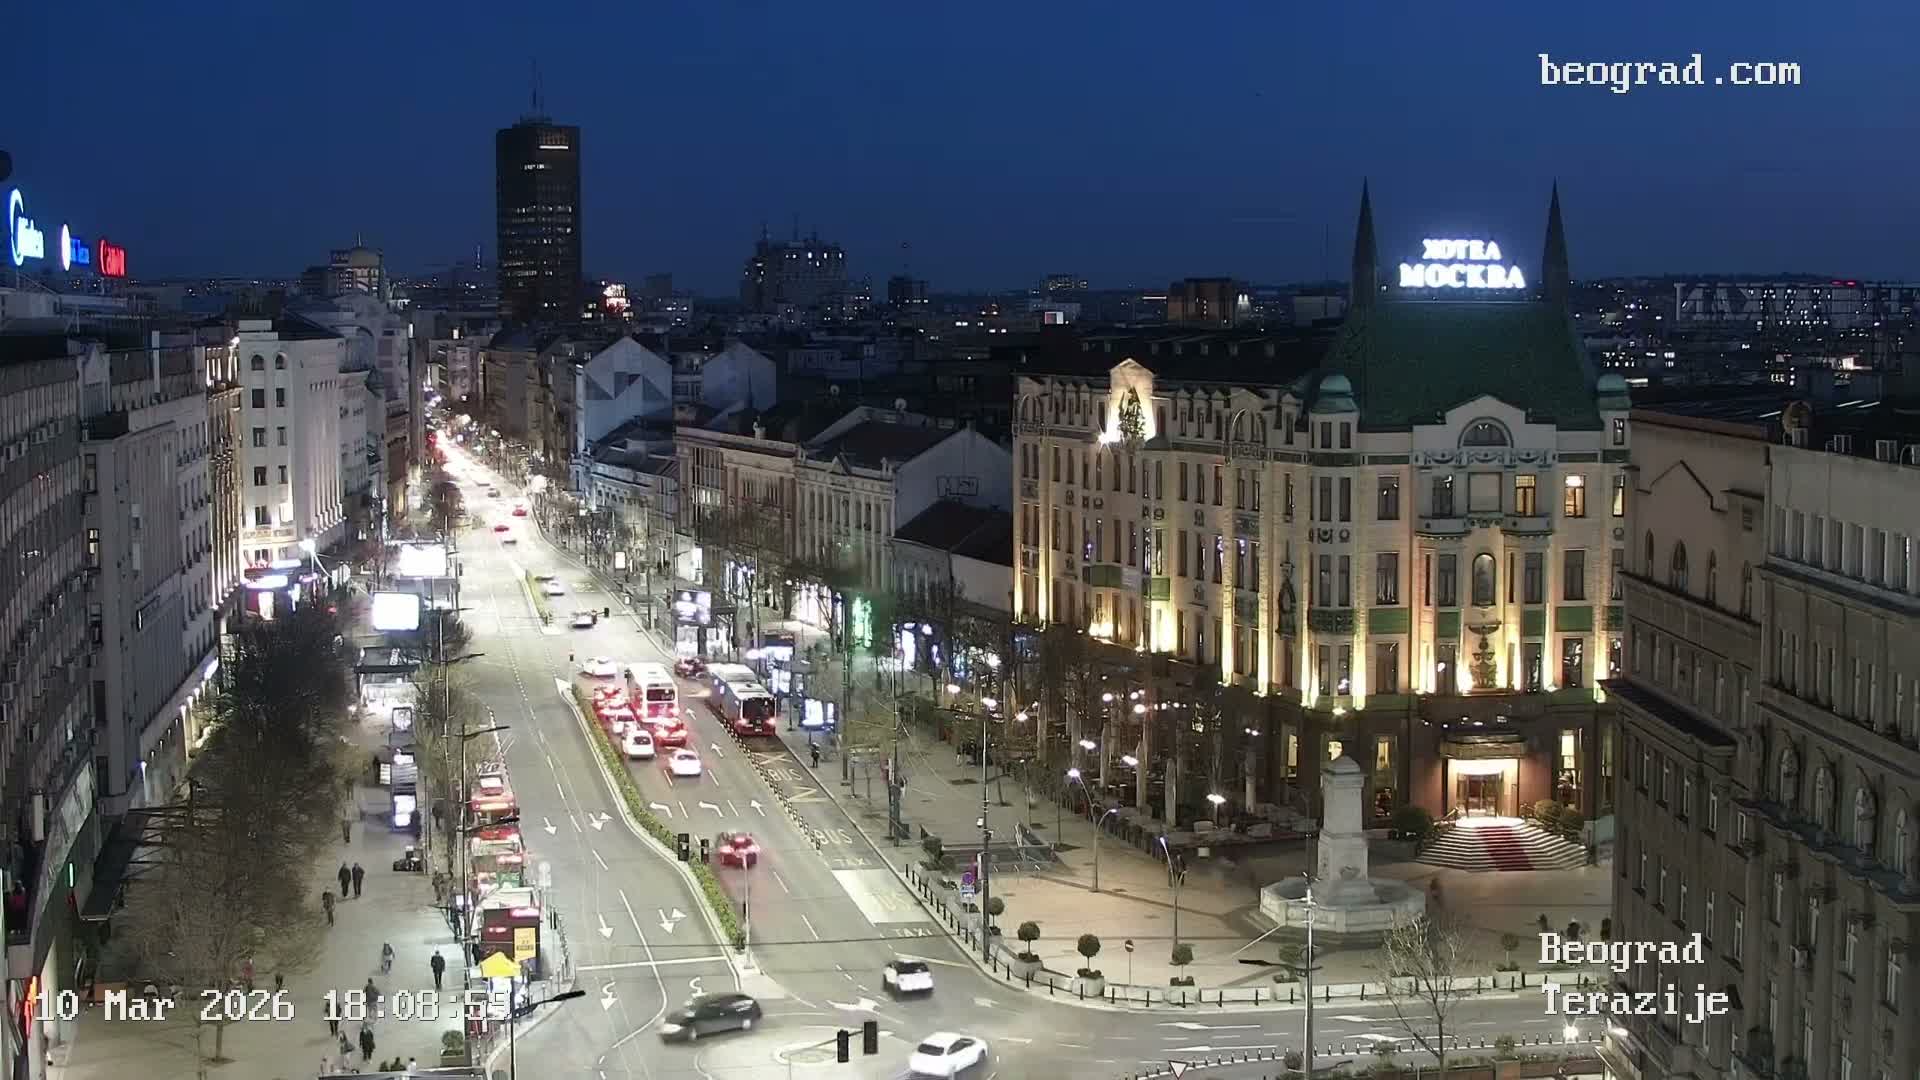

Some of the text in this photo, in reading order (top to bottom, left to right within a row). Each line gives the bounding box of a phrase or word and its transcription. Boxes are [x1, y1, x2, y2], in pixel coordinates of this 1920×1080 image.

[1399, 262, 1527, 289] МОСКВА
[768, 768, 803, 781] BUS
[814, 828, 853, 845] BUS
[892, 927, 933, 938] TAXI
